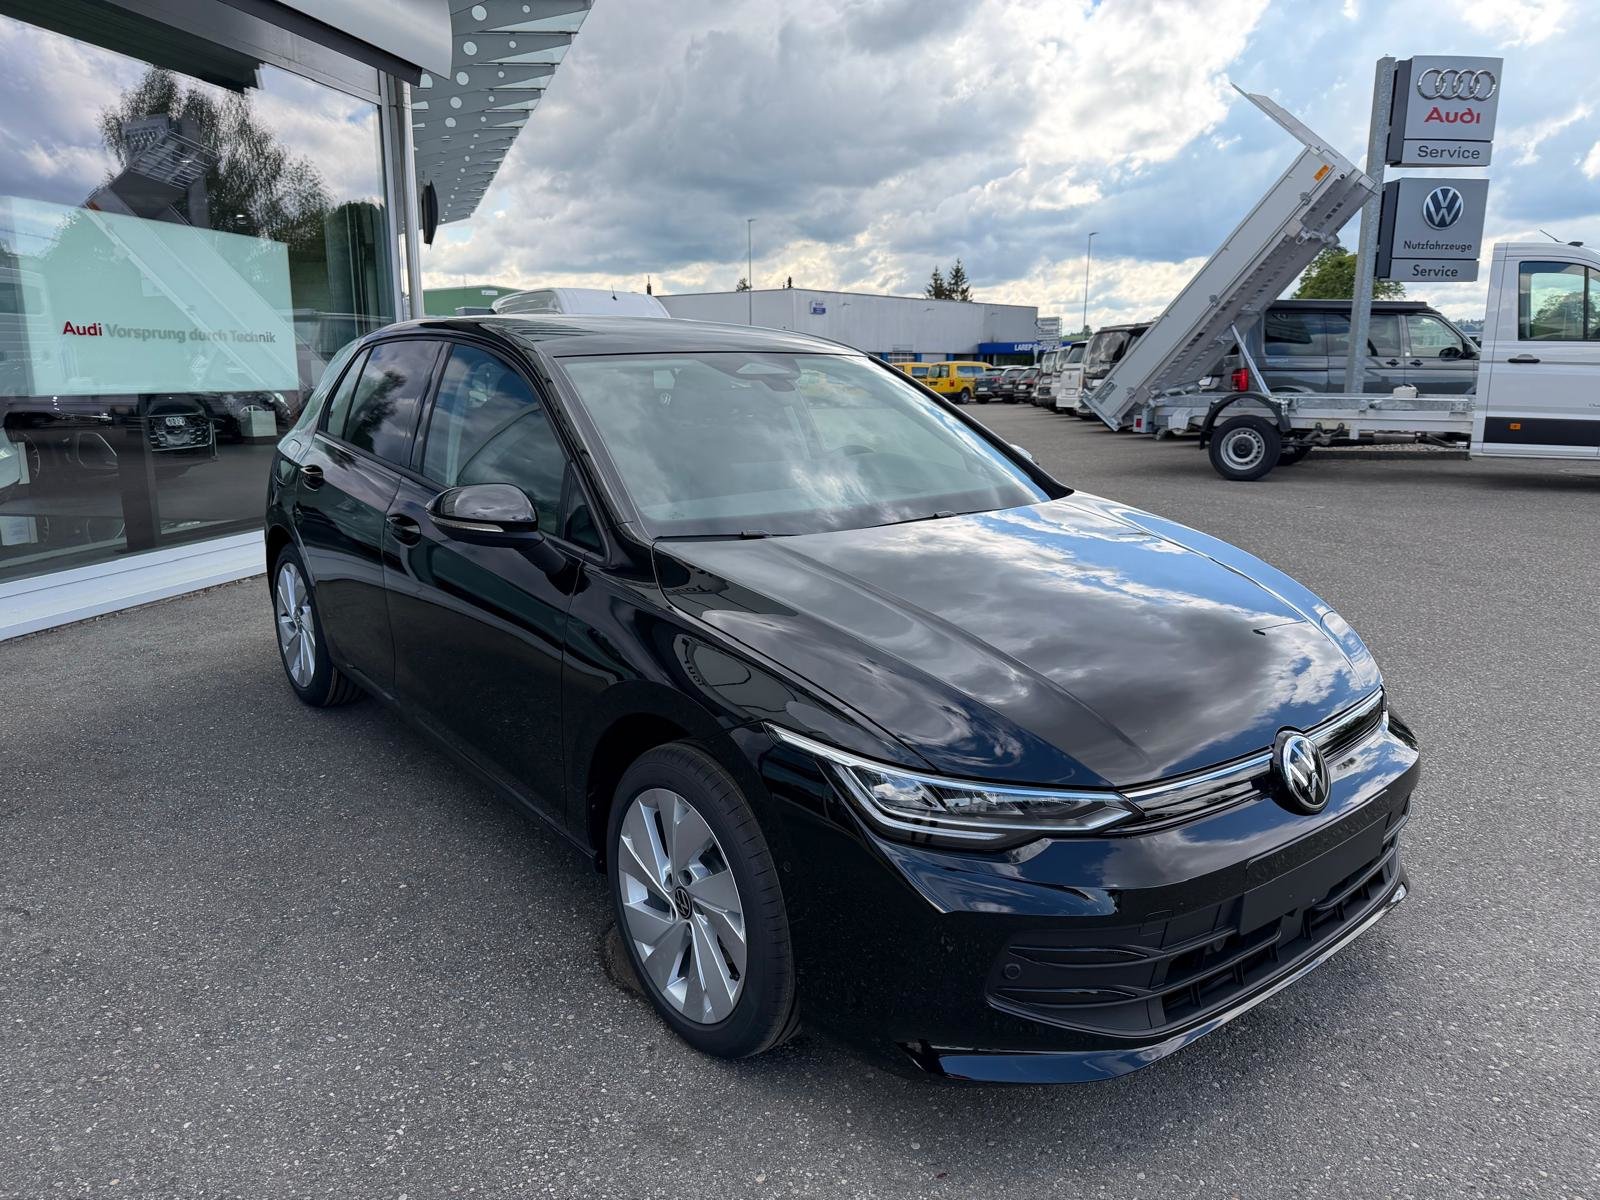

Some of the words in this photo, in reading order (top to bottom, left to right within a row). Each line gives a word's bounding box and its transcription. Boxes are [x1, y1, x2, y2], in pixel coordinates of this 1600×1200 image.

[1424, 106, 1481, 124] Audi
[1417, 145, 1480, 159] Service
[1423, 186, 1464, 230] VW
[1403, 240, 1473, 253] Nutzfahrzeuge
[1412, 263, 1458, 277] Service
[63, 320, 103, 336] Audi
[105, 323, 186, 343] Vorsprung
[189, 328, 227, 342] durch
[229, 330, 276, 343] Technik
